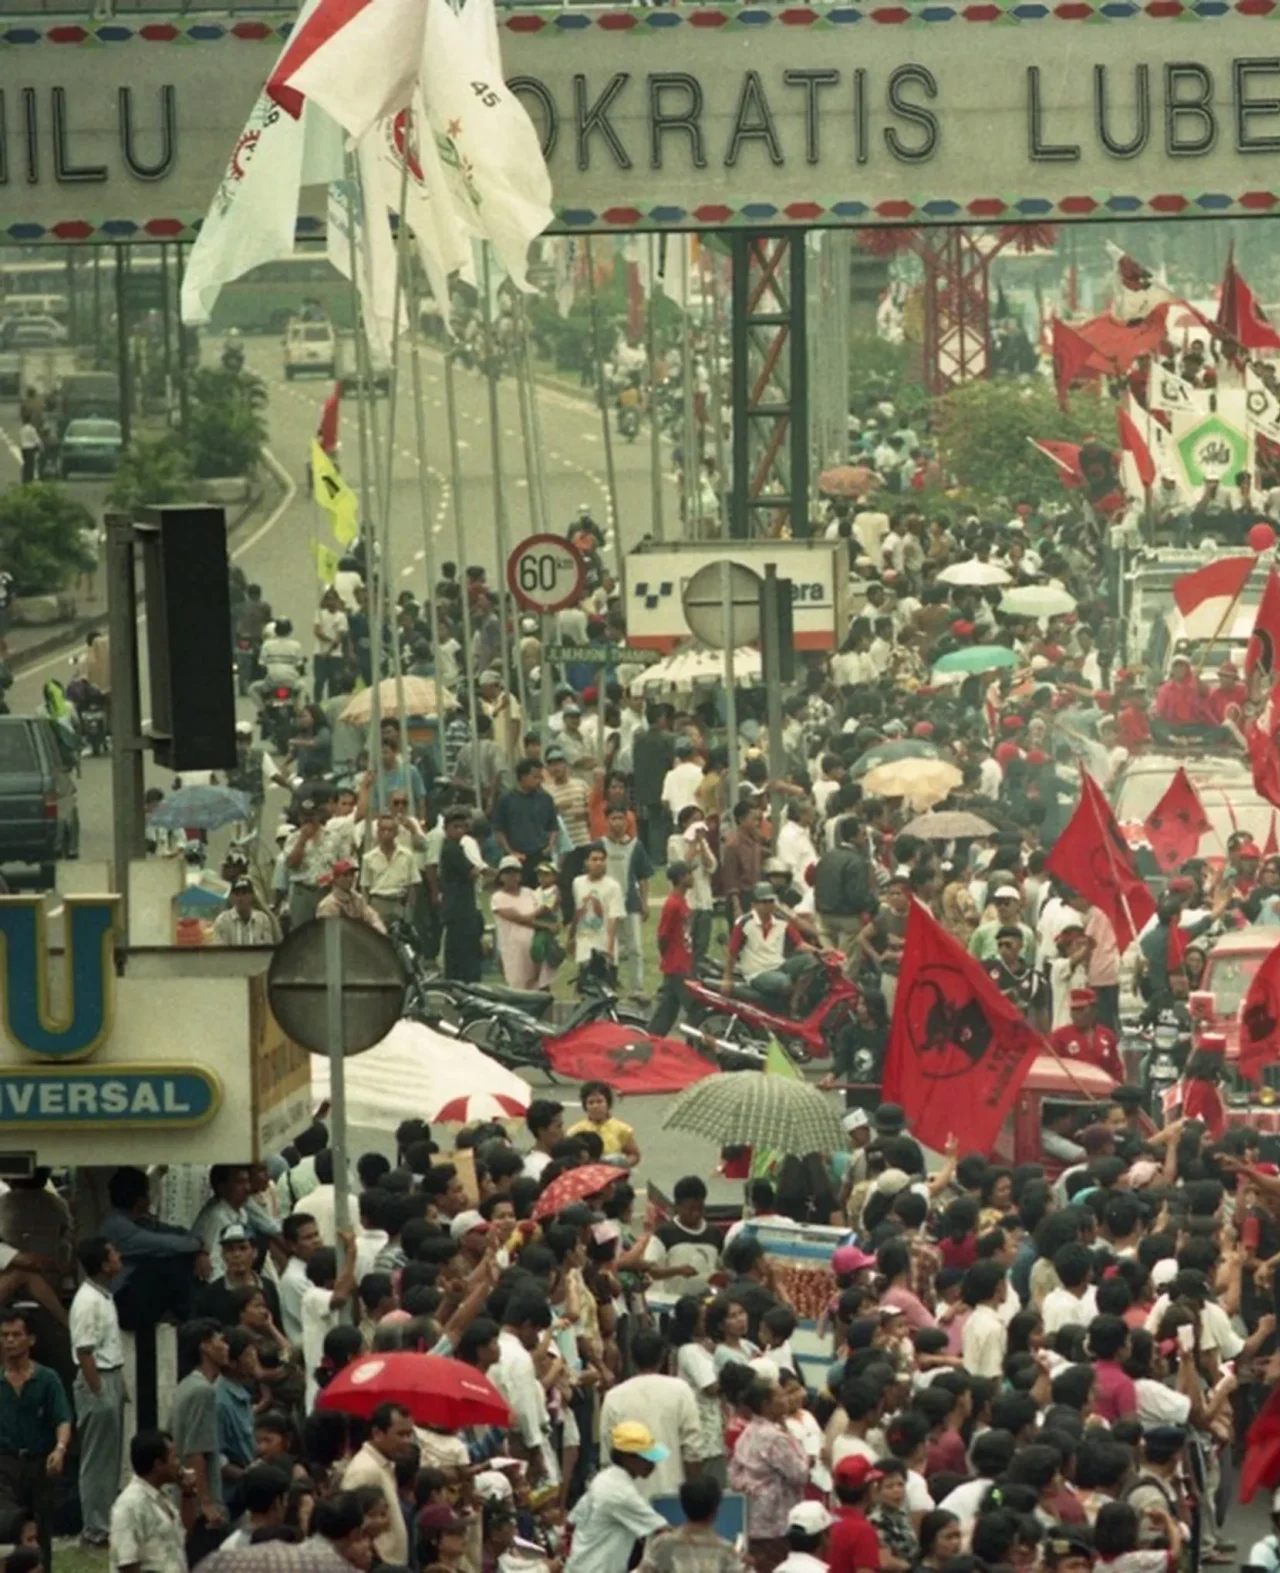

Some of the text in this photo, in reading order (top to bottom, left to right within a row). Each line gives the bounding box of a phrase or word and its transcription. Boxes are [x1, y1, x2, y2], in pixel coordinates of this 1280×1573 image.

[0, 85, 178, 184] ILU
[520, 554, 556, 591] 60
[0, 1081, 190, 1114] VERSAL
